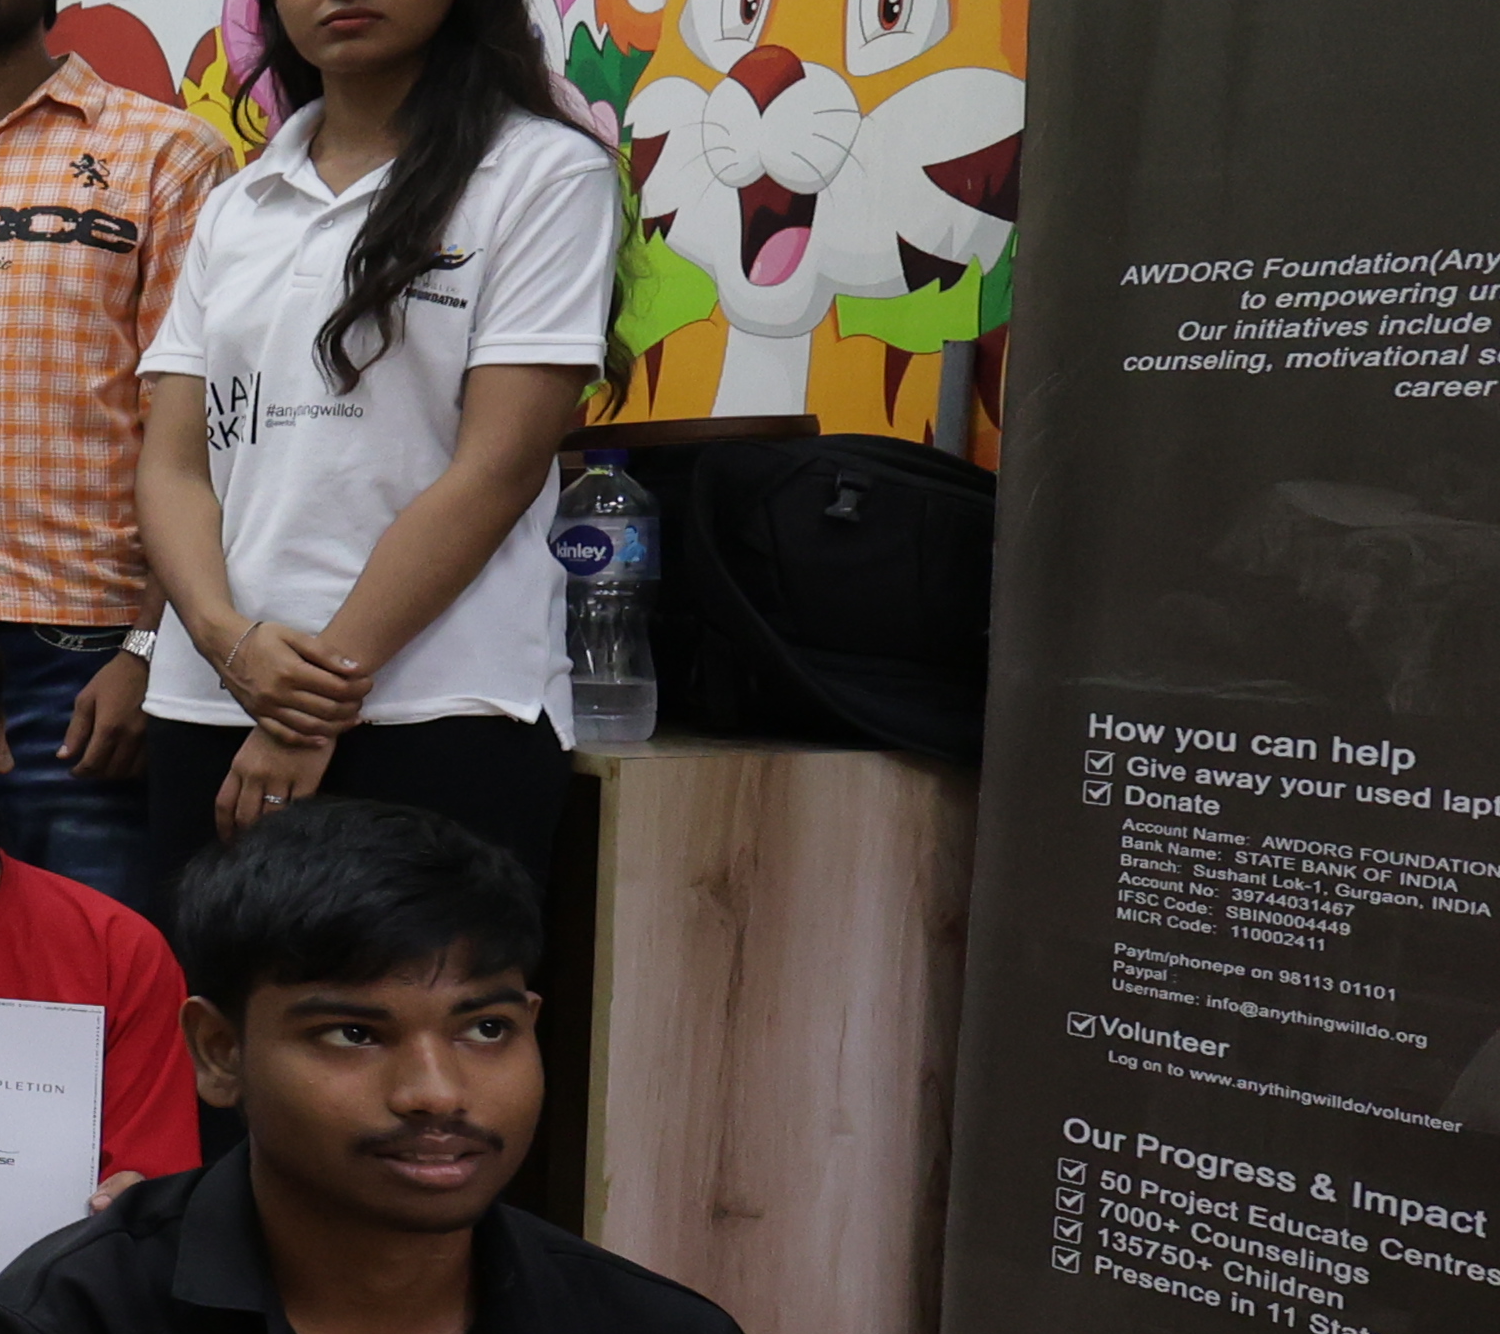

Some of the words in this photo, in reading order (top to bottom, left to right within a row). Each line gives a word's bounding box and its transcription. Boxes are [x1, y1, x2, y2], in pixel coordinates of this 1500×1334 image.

[1120, 259, 1254, 286] AWDORG
[1241, 290, 1266, 310] to
[1275, 283, 1458, 311] empowering
[1178, 321, 1226, 342] Our
[1233, 317, 1368, 340] initiatives
[1378, 313, 1492, 335] include
[1123, 350, 1273, 374] counseling,
[1285, 345, 1468, 369] motivational
[1394, 379, 1497, 398] career
[1088, 713, 1165, 745] How
[1174, 727, 1237, 753] you
[1251, 733, 1317, 760] can
[1332, 736, 1416, 775] help
[1124, 785, 1221, 816] Donate
[1126, 756, 1187, 782] Give
[1195, 770, 1271, 796] away
[1280, 776, 1347, 800] your
[1356, 783, 1431, 809] used
[1121, 836, 1163, 853] Bank
[1167, 842, 1221, 862] Name:
[1234, 851, 1296, 871] STATE
[1302, 859, 1358, 880] BANK
[1363, 868, 1392, 884] OF
[1400, 872, 1459, 893] INDIA
[1122, 818, 1188, 840] Account
[1193, 827, 1250, 846] Name:
[1262, 836, 1353, 859] AWDORG
[1360, 848, 1500, 878] FOUNDATION
[1118, 872, 1184, 895] Account
[1189, 882, 1219, 898] No:
[1231, 887, 1356, 917] 39744031467
[1118, 889, 1159, 907] IFSC
[1164, 895, 1213, 916] Code:
[1120, 854, 1181, 875] Branch:
[1193, 865, 1268, 887] Sushant
[1432, 896, 1492, 917] INDIA
[1116, 907, 1162, 926] MICR
[1167, 914, 1217, 935] Code:
[1231, 925, 1326, 951] 110002411
[1113, 960, 1168, 982] Paypal
[1114, 942, 1246, 977] Paytm/phonepe
[1250, 966, 1274, 981] on
[1278, 970, 1334, 991] 98113
[1339, 982, 1396, 1002] 01101
[1099, 1015, 1231, 1058] Volunteer
[1112, 978, 1200, 1007] Username:
[1205, 995, 1429, 1049] info@anythingwilldo.org
[1108, 1050, 1138, 1072] Log
[1142, 1058, 1163, 1074] on
[1167, 1062, 1185, 1077] to
[1189, 1069, 1463, 1134] www.anythingwilldo/volunteer
[1063, 1117, 1126, 1153] Our
[1136, 1133, 1298, 1193] Progress
[1310, 1173, 1337, 1203] &
[1352, 1182, 1488, 1239] Impact
[1099, 1198, 1180, 1233] 7000+
[1190, 1222, 1370, 1286] Counselings
[1100, 1169, 1132, 1195] 50
[1140, 1180, 1239, 1222] Project
[1248, 1205, 1369, 1254] Educate
[1379, 1237, 1500, 1287] Centres
[1094, 1255, 1221, 1307] Presence
[1231, 1292, 1256, 1316] in
[1267, 1302, 1296, 1328] 11
[1098, 1228, 1212, 1272] 135750+
[1223, 1260, 1345, 1310] Children
